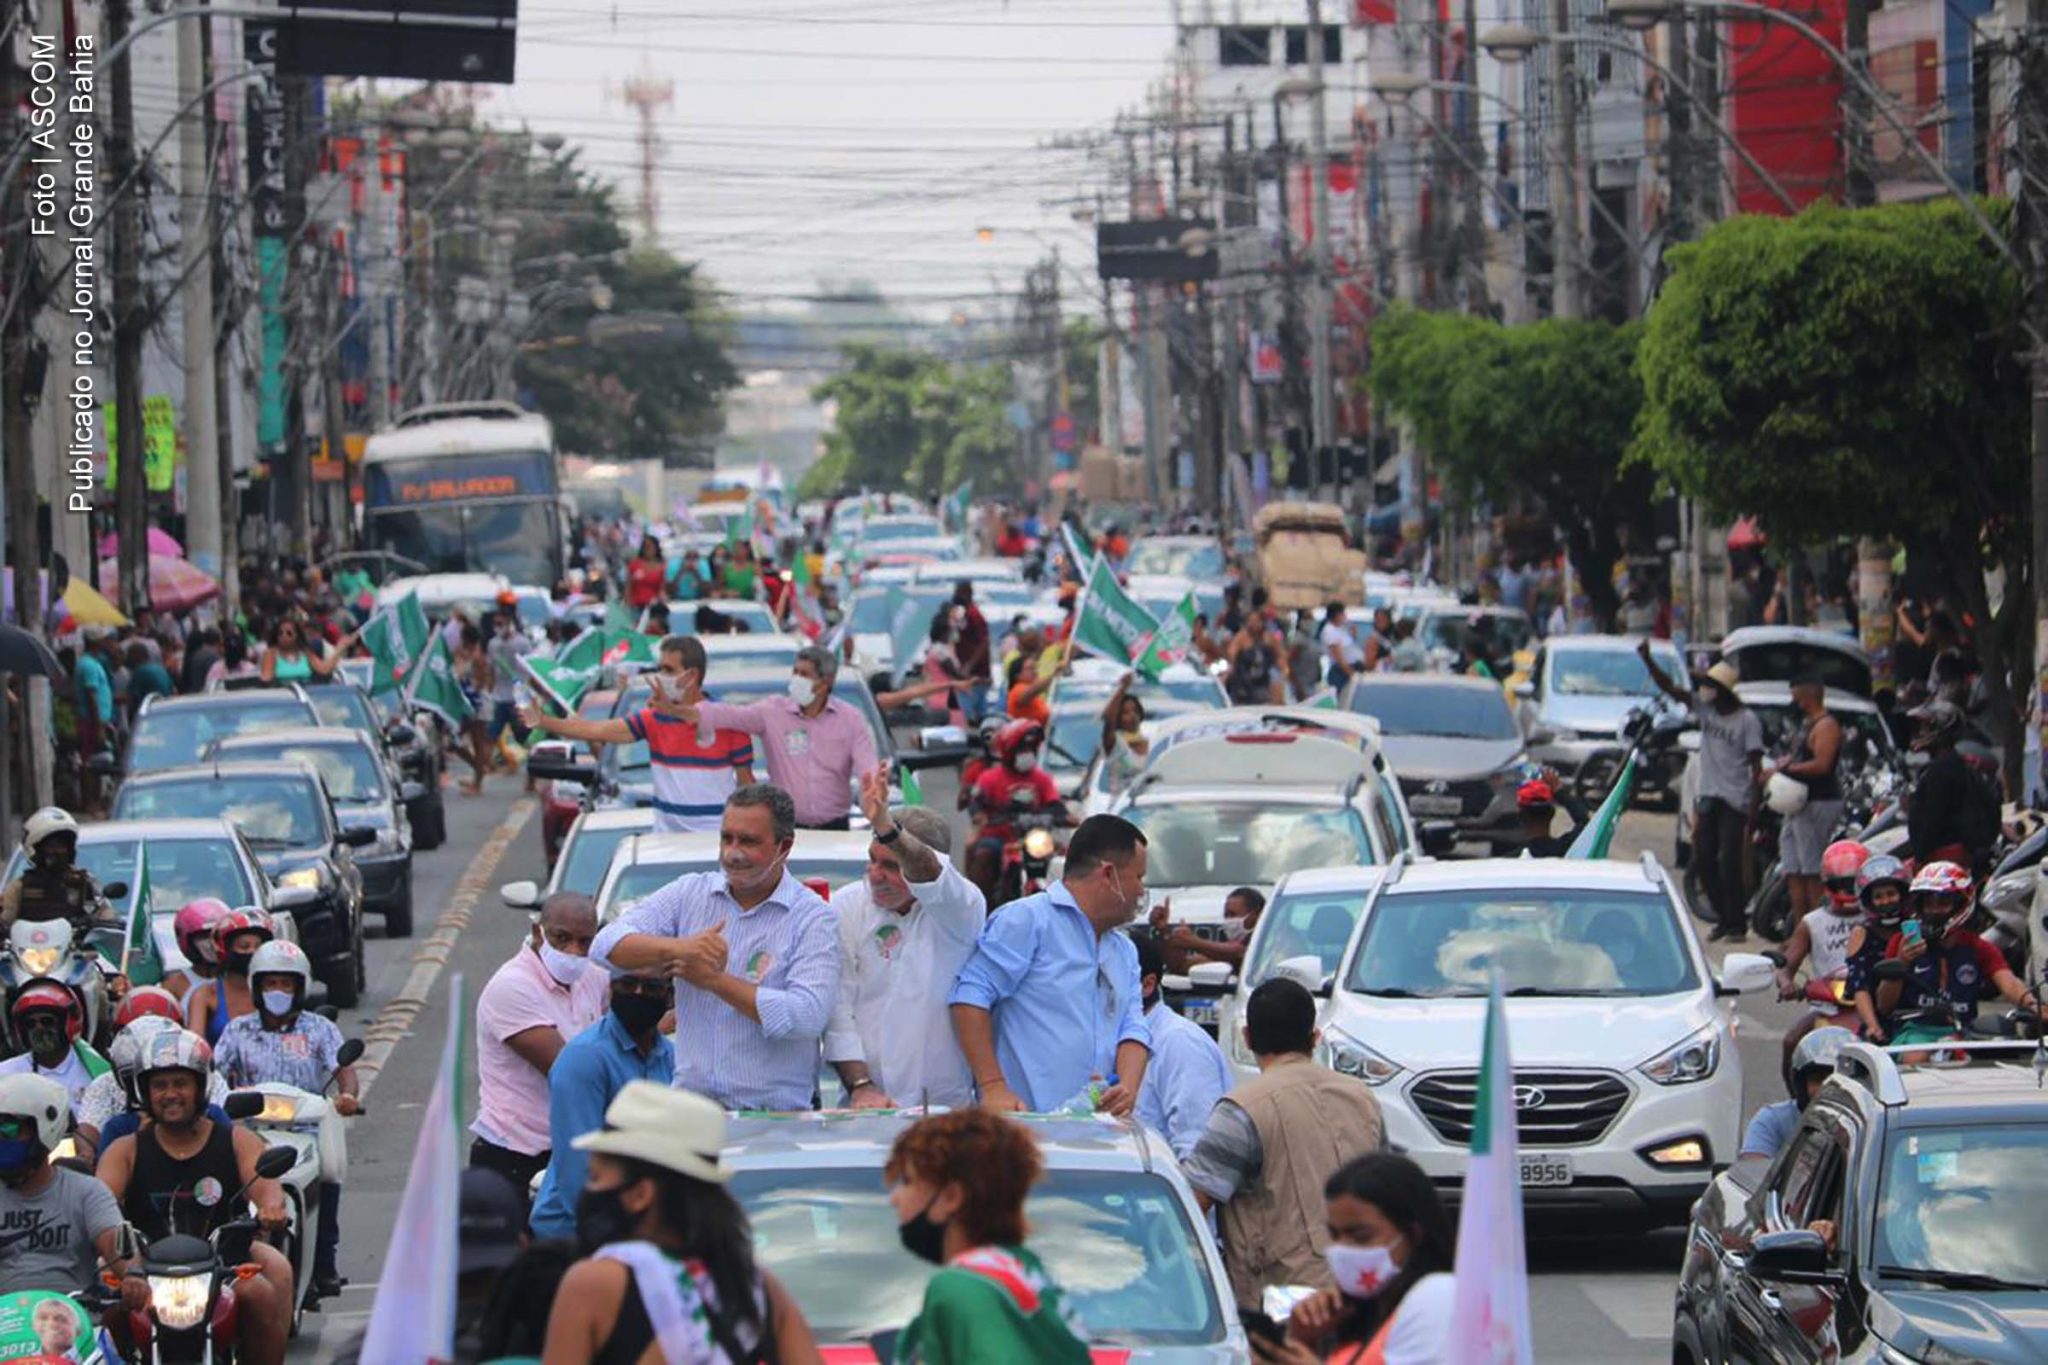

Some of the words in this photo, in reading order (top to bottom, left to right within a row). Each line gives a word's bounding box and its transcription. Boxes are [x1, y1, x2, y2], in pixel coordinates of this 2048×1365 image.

[1521, 1164, 1568, 1182] 8956
[0, 1209, 43, 1230] JUST
[28, 1227, 54, 1250] DO
[55, 1224, 71, 1246] IT
